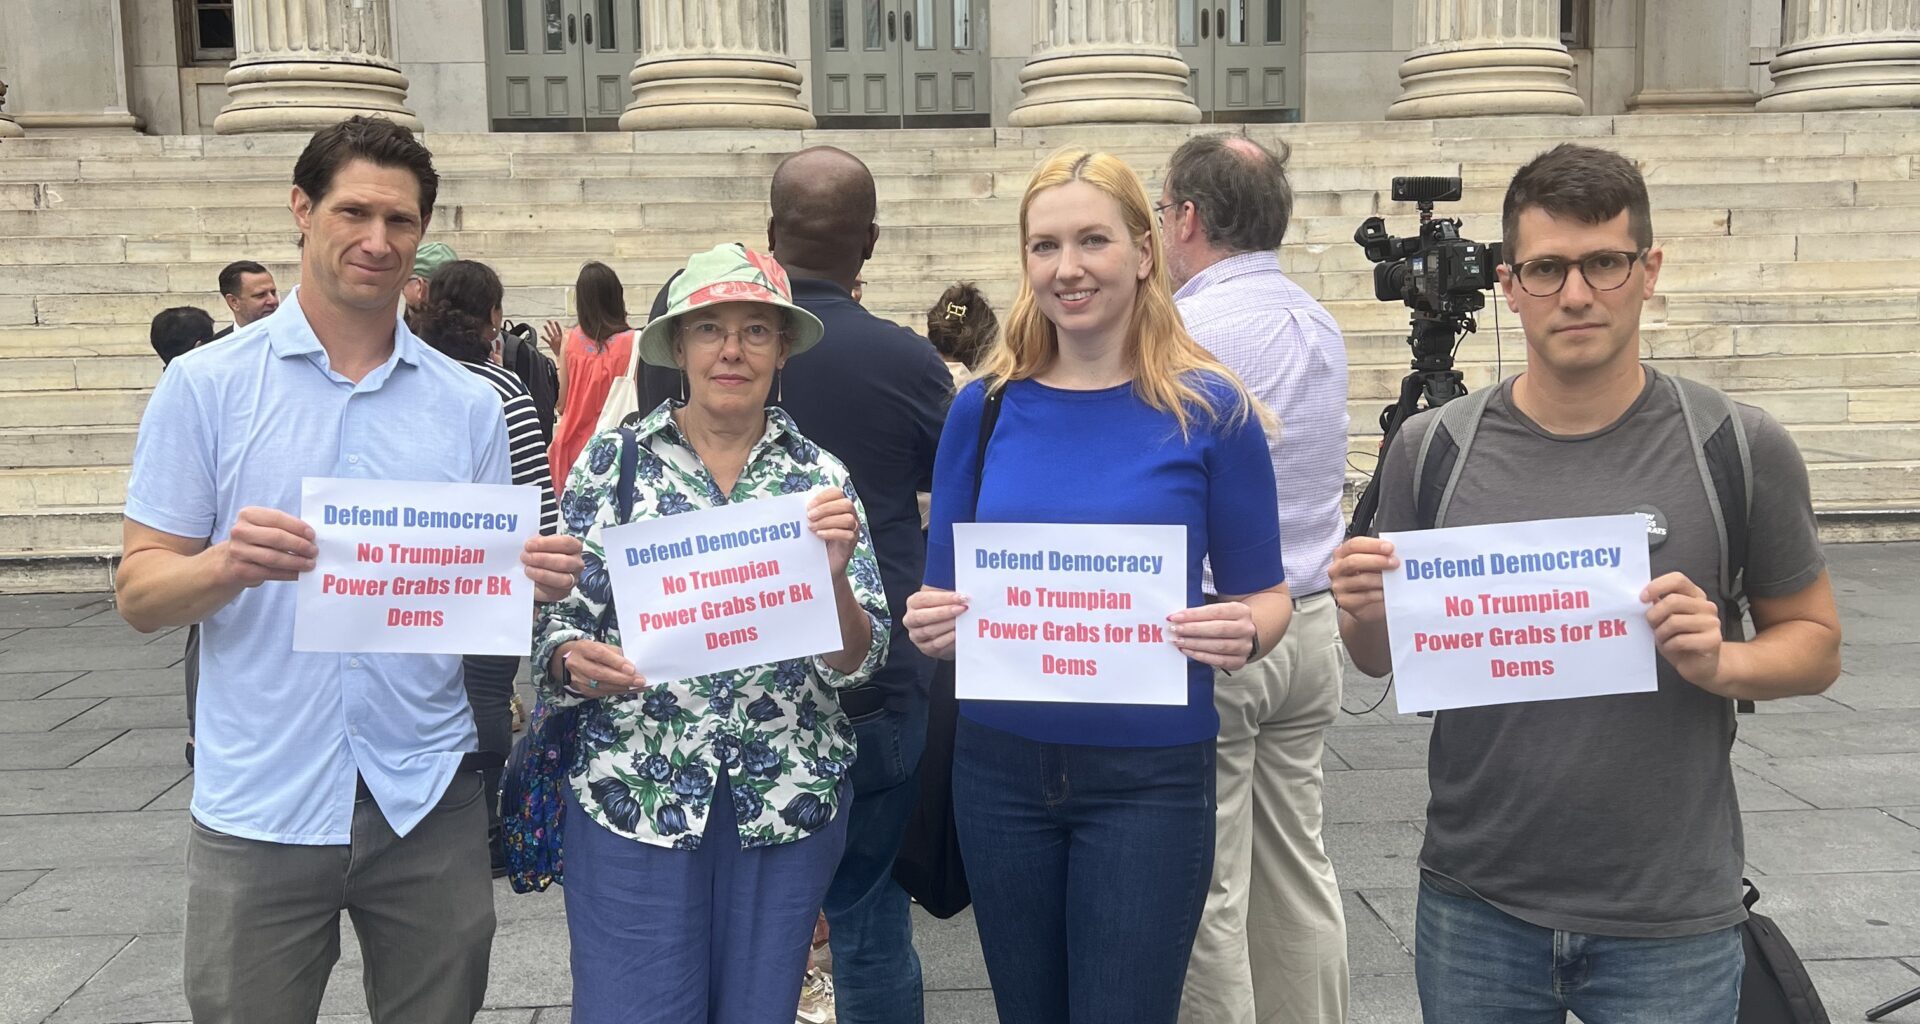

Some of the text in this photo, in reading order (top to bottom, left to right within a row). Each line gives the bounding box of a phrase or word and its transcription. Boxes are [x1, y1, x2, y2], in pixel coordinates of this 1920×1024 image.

[324, 504, 518, 532] Defend Democracy
[357, 543, 485, 566] No Trumpian
[625, 520, 801, 566] Defend Democracy
[975, 548, 1163, 574] Defend Democracy
[1405, 547, 1621, 580] Defend Democracy
[323, 574, 512, 596] Power Grabs for Bk
[662, 560, 780, 595] No Trumpian
[639, 583, 814, 632] Power Grabs for Bk
[1007, 587, 1132, 610] No Trumpian
[1445, 589, 1590, 617] No Trumpian
[387, 608, 444, 627] Dems
[705, 626, 759, 651] Dems
[978, 619, 1164, 643] Power Grabs for Bk
[1414, 619, 1627, 652] Power Grabs for Bk
[1042, 655, 1097, 676] Dems
[1491, 659, 1555, 678] Dems
